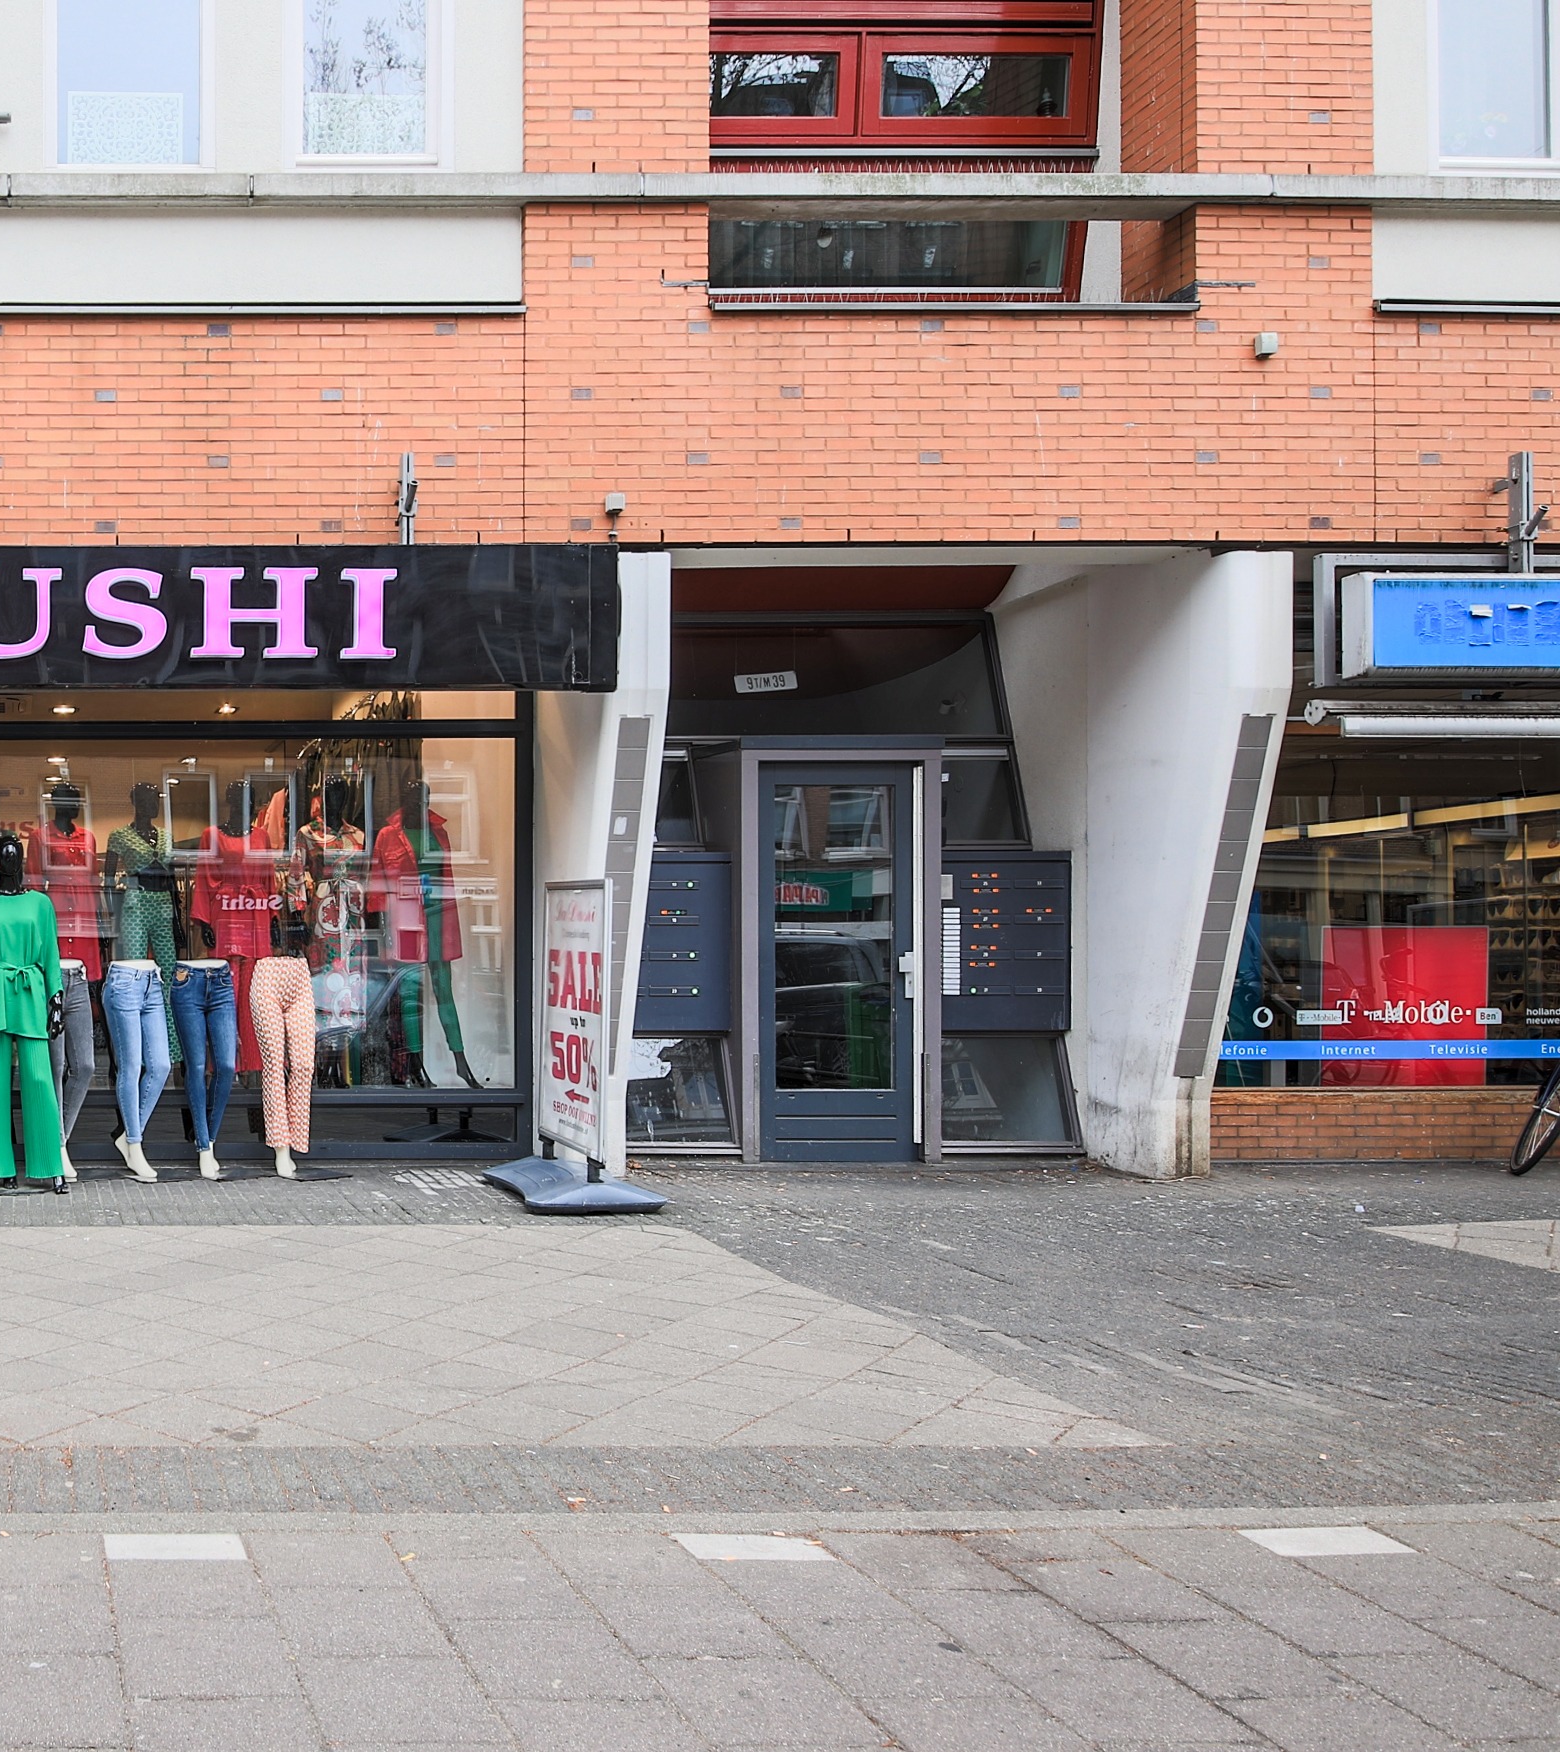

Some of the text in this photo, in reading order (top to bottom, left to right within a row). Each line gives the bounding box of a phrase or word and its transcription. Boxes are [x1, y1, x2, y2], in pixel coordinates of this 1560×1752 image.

[548, 949, 601, 1015] SALE
[550, 1030, 597, 1092] 50%
[1221, 1045, 1267, 1055] lefonie
[1321, 1045, 1376, 1055] Internet
[1429, 1044, 1488, 1054] Televisie
